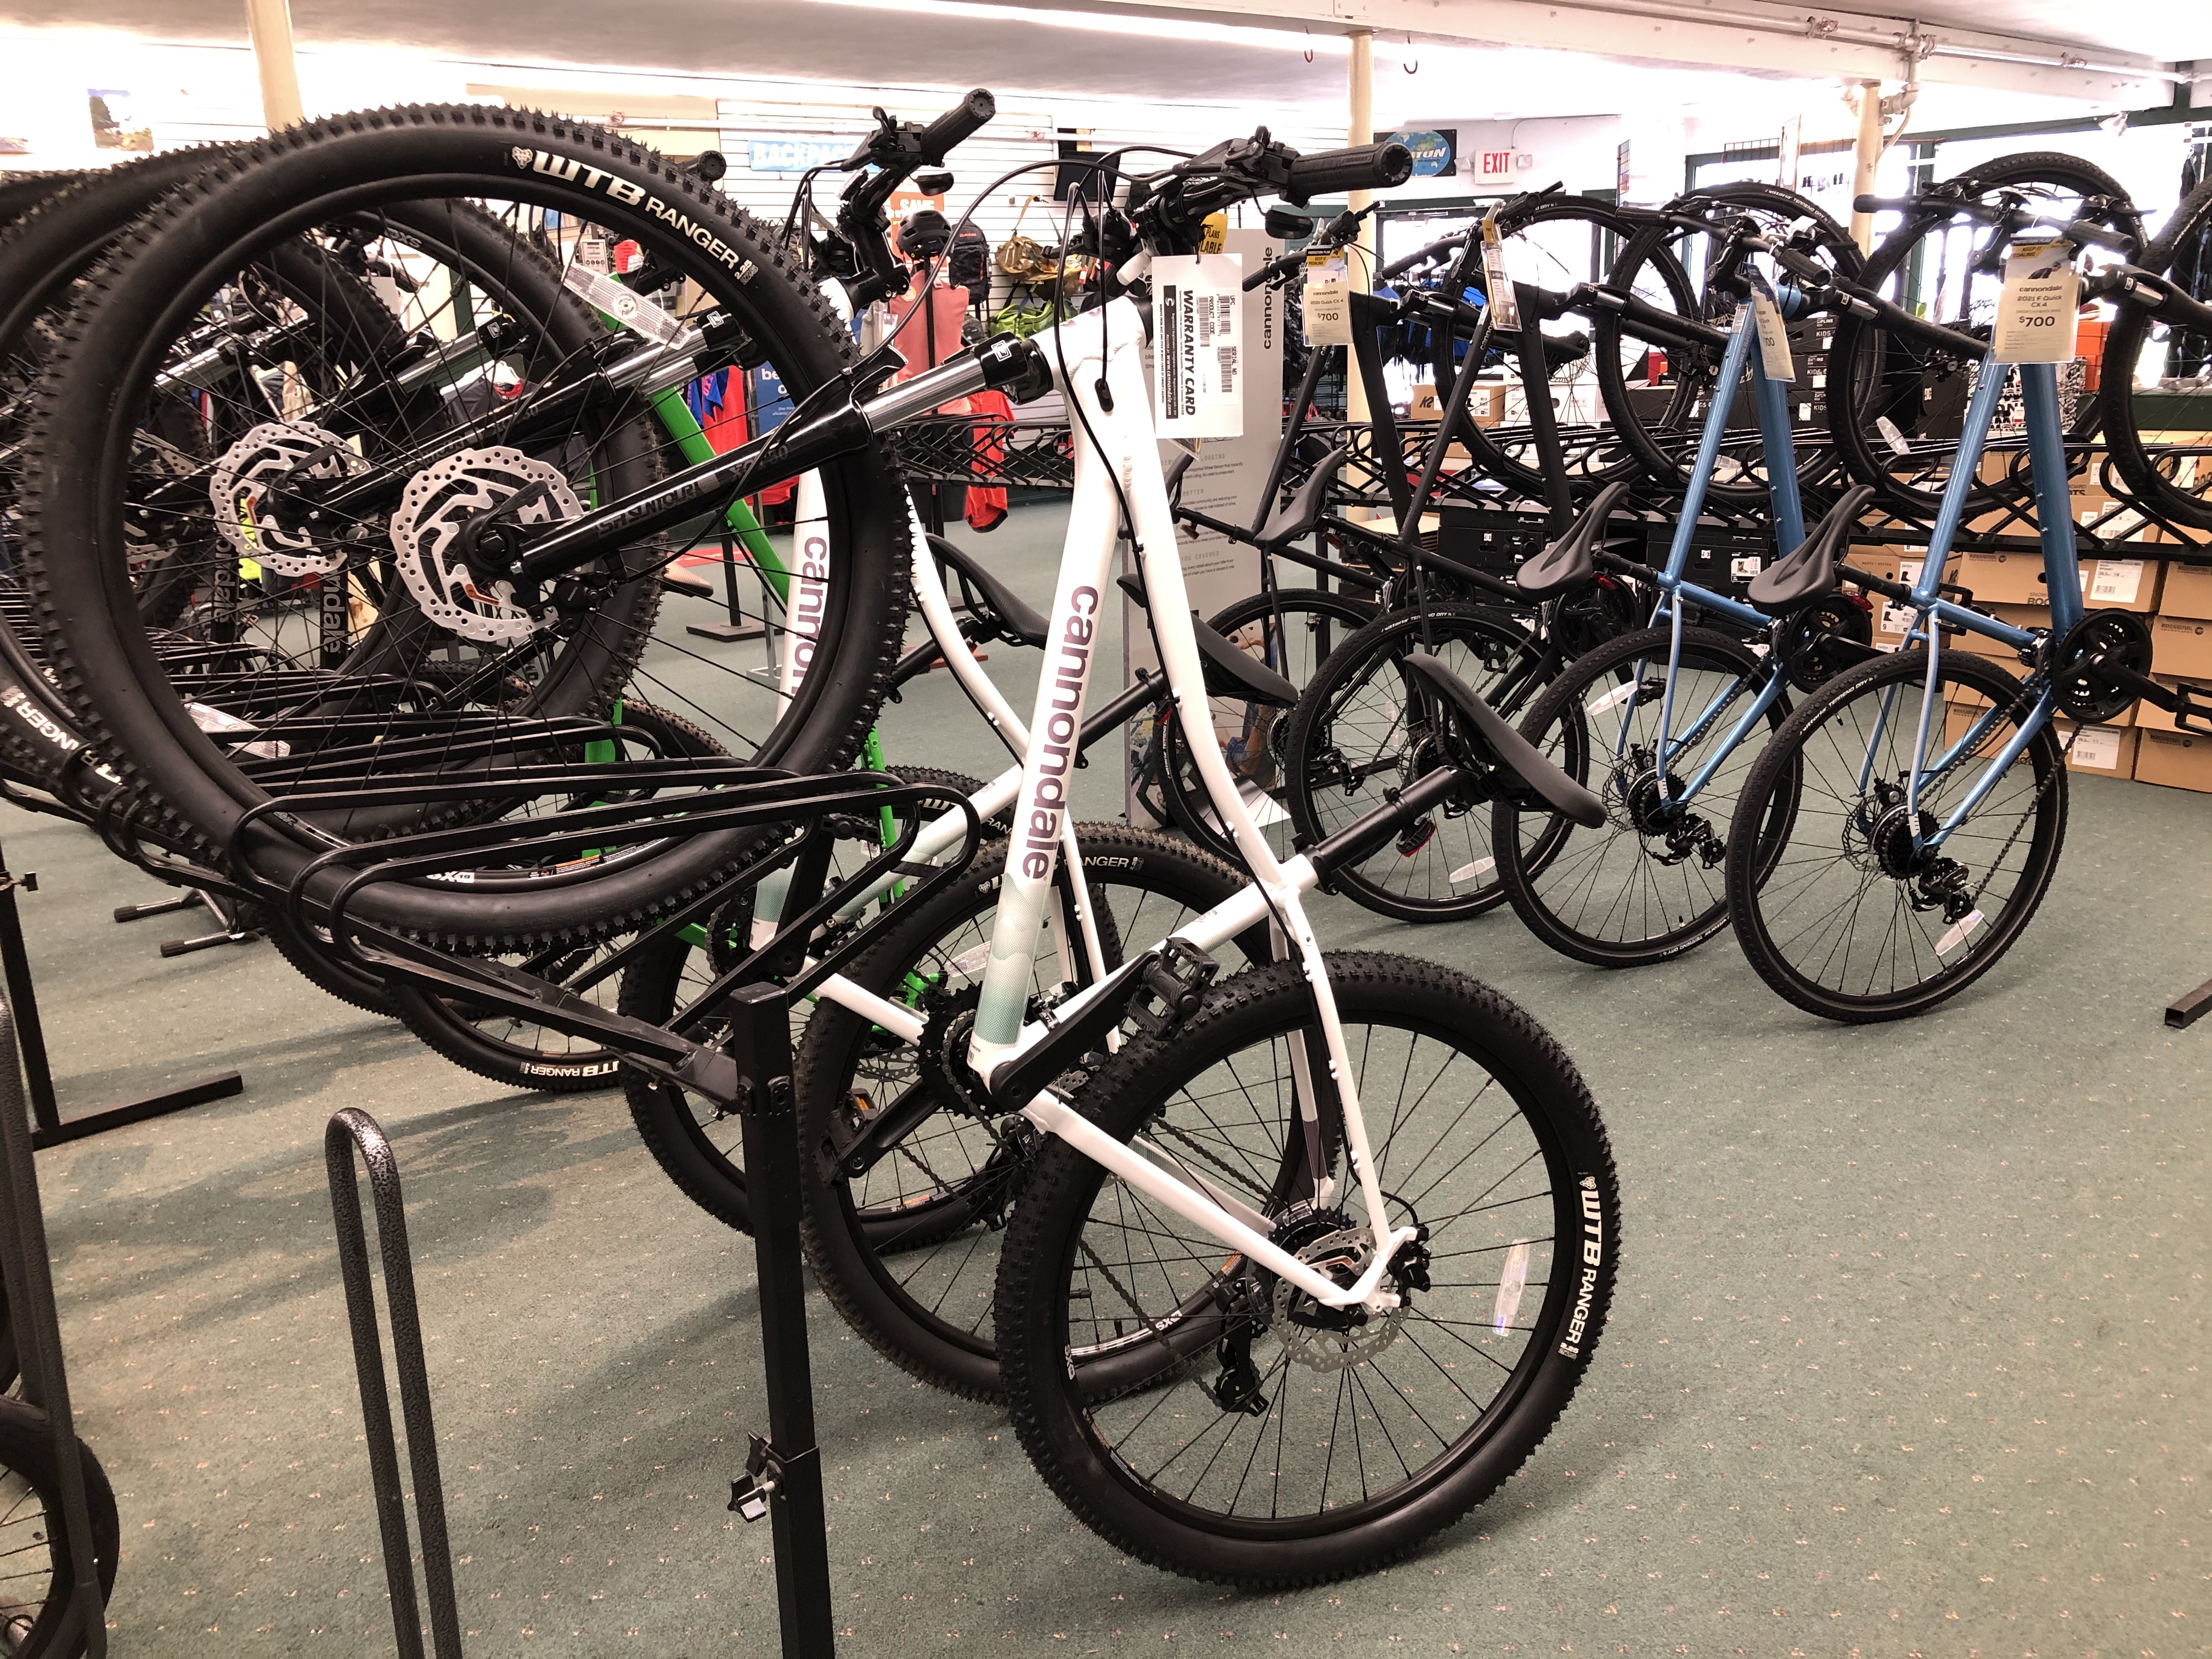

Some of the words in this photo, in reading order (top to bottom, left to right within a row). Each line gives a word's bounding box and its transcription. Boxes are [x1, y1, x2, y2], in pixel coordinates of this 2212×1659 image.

[1483, 152, 1510, 174] EXIT
[532, 150, 646, 205] WTB
[645, 196, 740, 270] RANGER
[900, 199, 935, 211] SAVE
[1206, 229, 1220, 239] PLANS
[1263, 246, 1272, 349] cannonle
[1317, 312, 1339, 321] $700
[2019, 315, 2055, 327] $700
[1183, 290, 1194, 374] WARRANTY
[1184, 377, 1195, 416] CARD
[1419, 396, 1434, 408] K2
[323, 572, 345, 654] ndale
[1384, 618, 1409, 631] vittoria
[2161, 623, 2194, 631] ROSSIGNOL
[1802, 706, 1827, 731] vittoria
[1829, 686, 1855, 708] TERRENO
[1855, 679, 1869, 689] DRY
[1022, 585, 1099, 880] cannondale
[531, 1065, 580, 1077] RANGER
[1581, 1189, 1602, 1267] WTB
[1565, 1267, 1597, 1345] RANGER
[1560, 1342, 1579, 1354] 2.25
